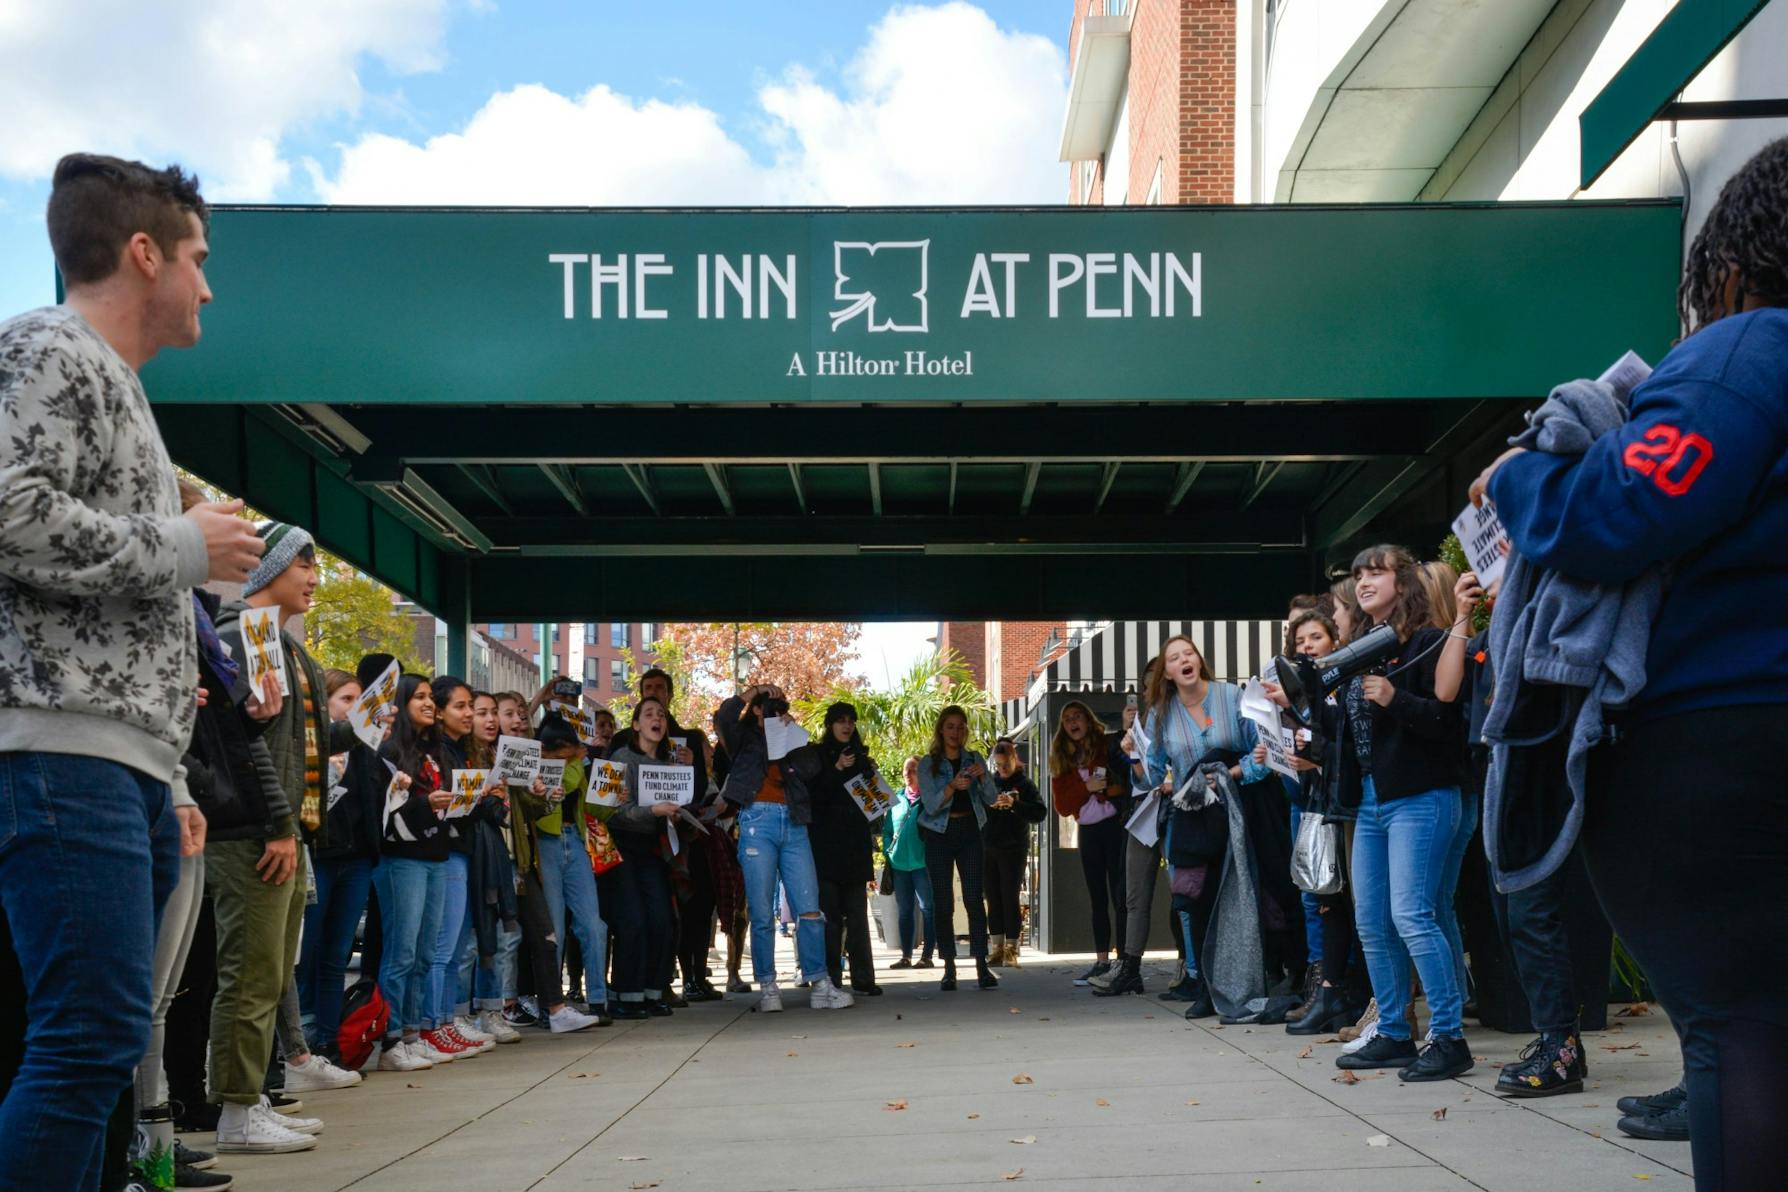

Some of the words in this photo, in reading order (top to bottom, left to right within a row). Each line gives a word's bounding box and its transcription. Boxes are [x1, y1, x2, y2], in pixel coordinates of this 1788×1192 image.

[550, 253, 673, 319] THE
[698, 253, 796, 319] INN
[961, 253, 1030, 319] AT
[1049, 252, 1202, 319] PENN
[786, 352, 807, 376] A
[816, 351, 896, 376] Hilton
[904, 351, 973, 376] Hotel
[1623, 423, 1713, 497] 20
[1321, 666, 1340, 685] PYLE
[642, 770, 660, 780] PENN
[660, 771, 692, 781] TRUSTEES
[645, 781, 662, 791] FUND
[662, 782, 689, 791] CLIMATE
[654, 792, 680, 801] CHANGE
